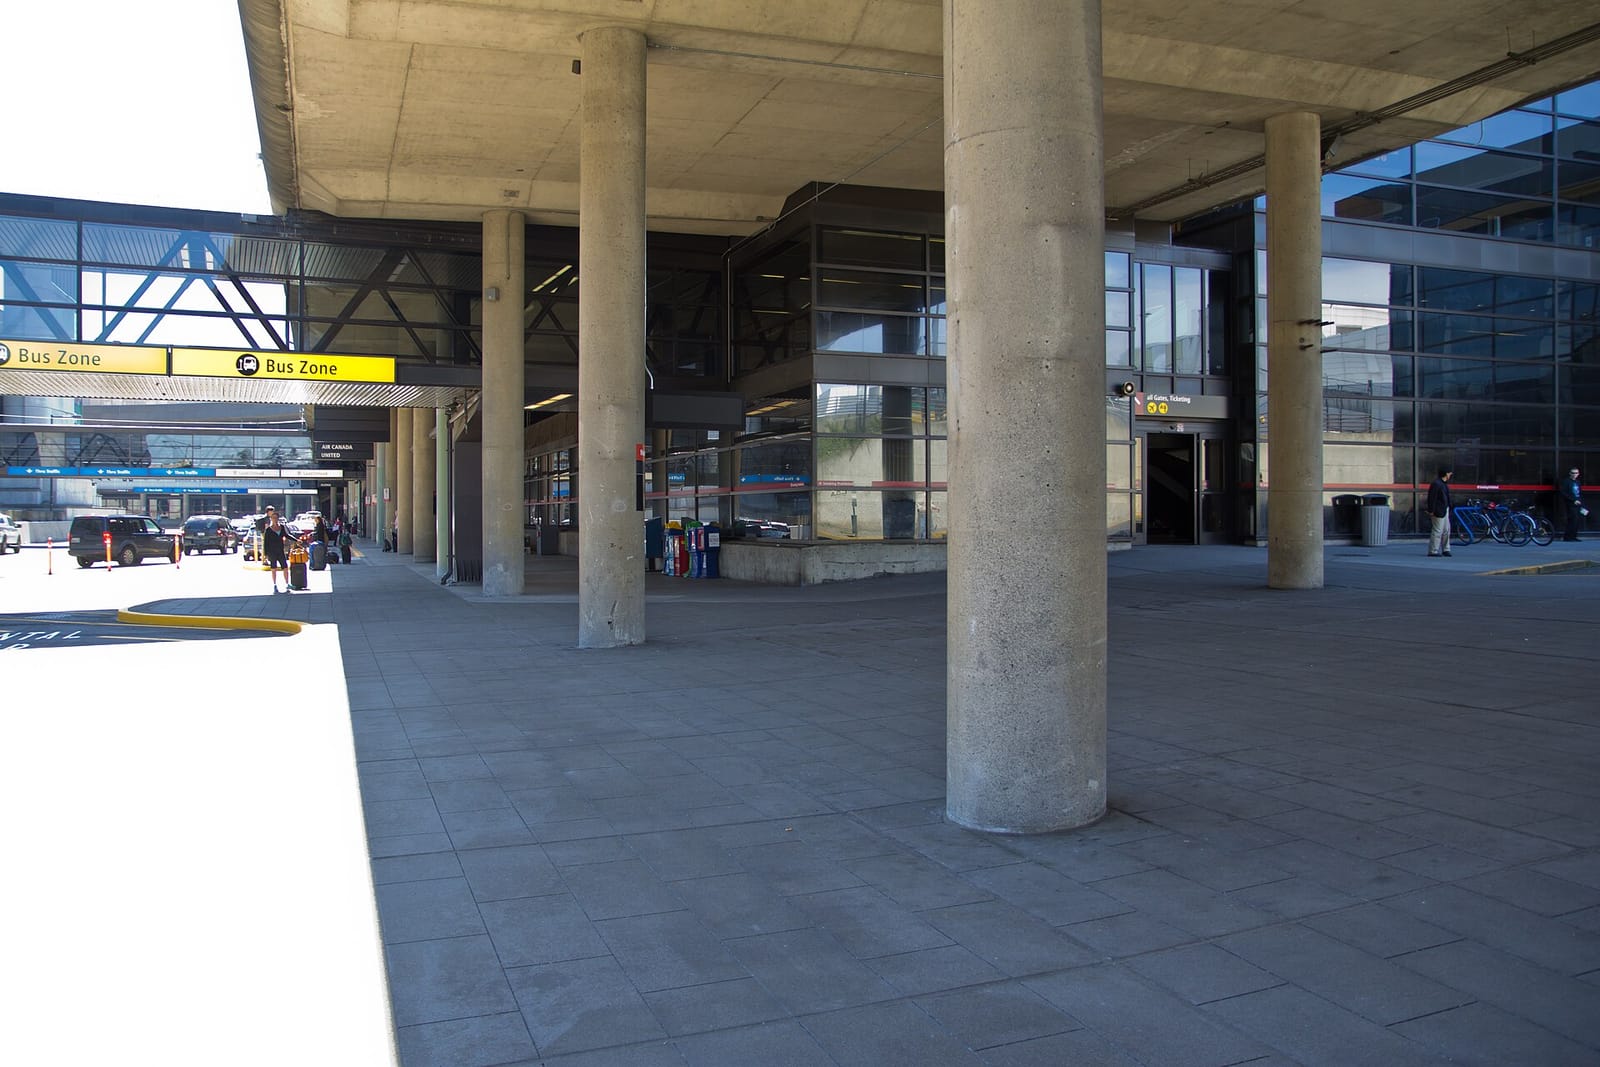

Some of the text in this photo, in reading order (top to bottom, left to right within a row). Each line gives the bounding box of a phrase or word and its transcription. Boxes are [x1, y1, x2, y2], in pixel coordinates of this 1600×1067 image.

[19, 348, 101, 366] Bus Zone
[266, 359, 338, 376] Bus Zone
[1170, 395, 1191, 404] Ticketing
